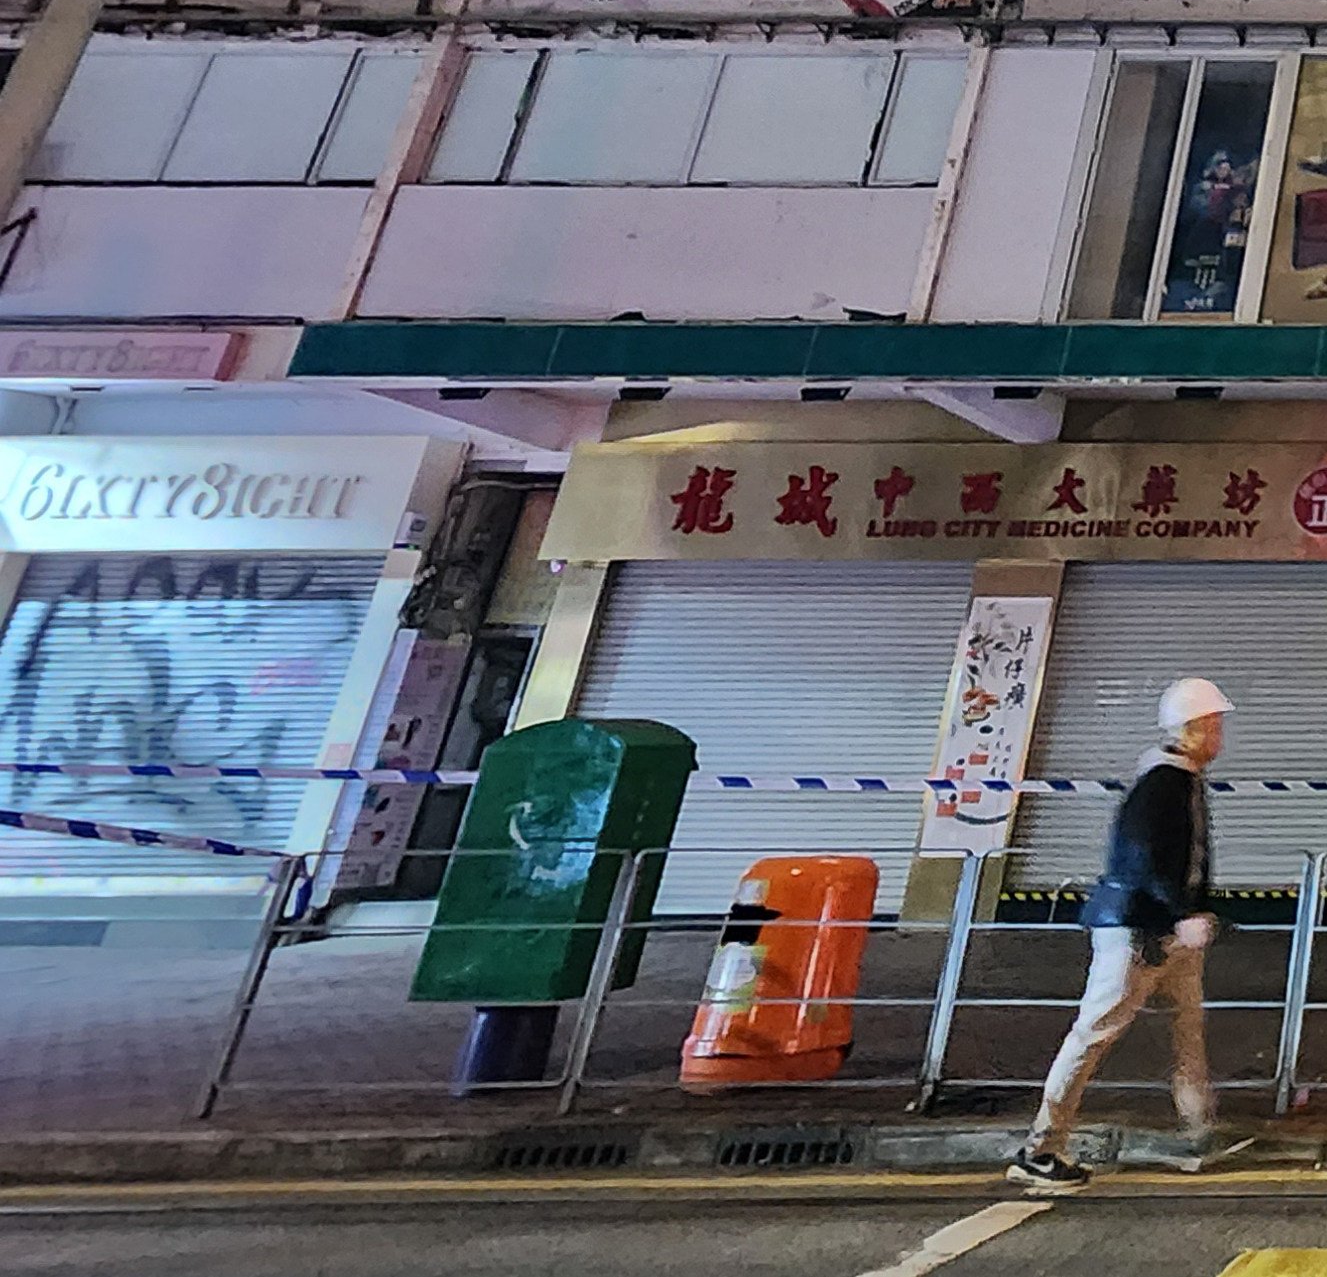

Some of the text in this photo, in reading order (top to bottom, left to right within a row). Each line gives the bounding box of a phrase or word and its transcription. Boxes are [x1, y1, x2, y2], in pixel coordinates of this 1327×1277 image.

[19, 462, 365, 520] 6IXTY8IGHT
[943, 520, 1001, 539] CITY
[1007, 519, 1128, 539] MEDICINE
[1136, 519, 1260, 539] COMPANY
